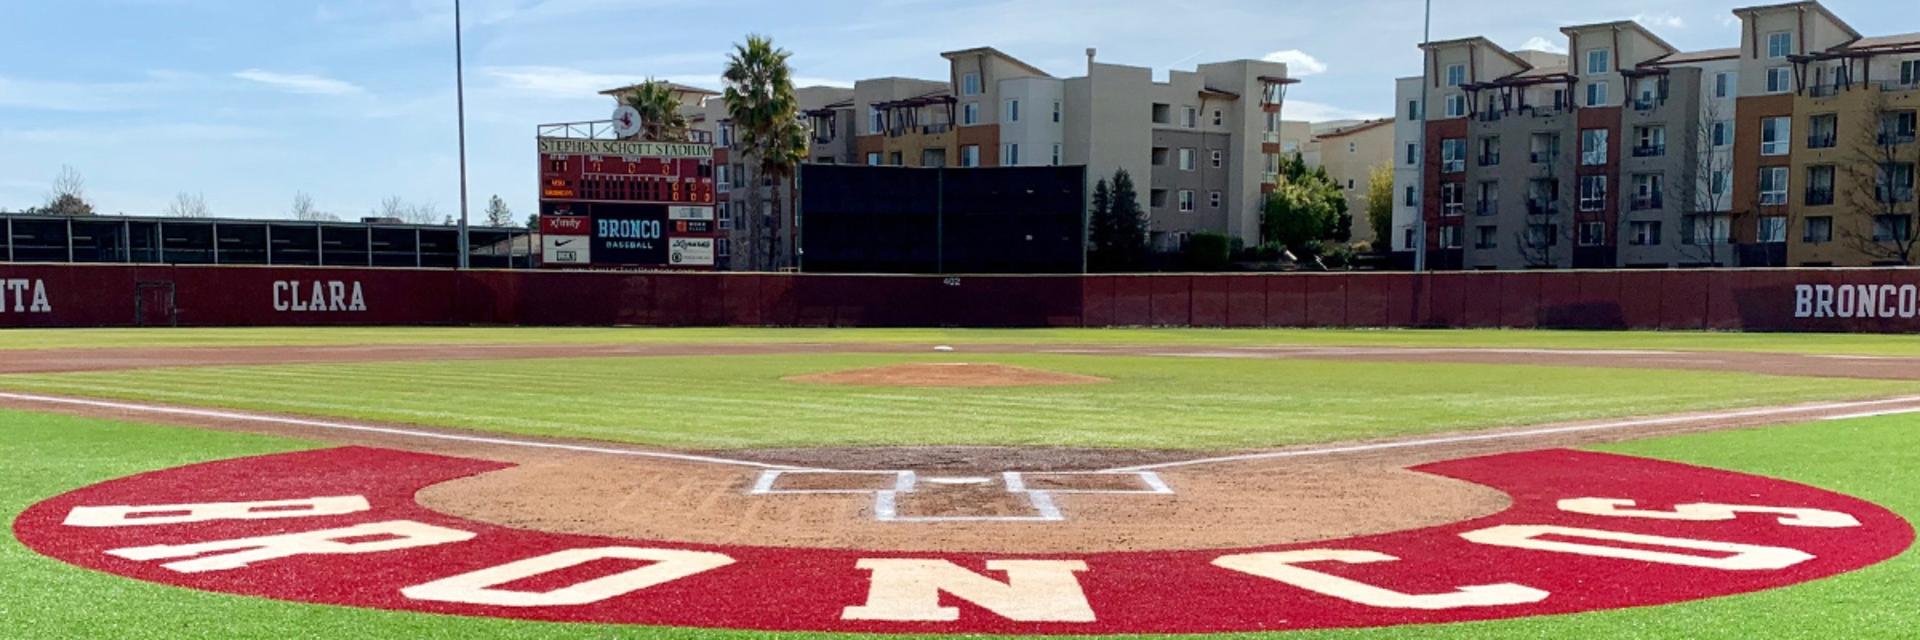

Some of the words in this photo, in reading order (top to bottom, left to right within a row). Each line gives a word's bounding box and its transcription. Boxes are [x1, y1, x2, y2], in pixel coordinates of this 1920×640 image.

[541, 139, 599, 152] STEPHEN
[602, 141, 651, 154] SCHOTT
[655, 143, 712, 157] STADIUM
[598, 219, 661, 239] BRONCO
[606, 241, 653, 250] BASEBALL
[273, 280, 367, 312] CLARA
[1794, 283, 1920, 318] BRONCO
[62, 495, 1860, 624] BRONCOS
